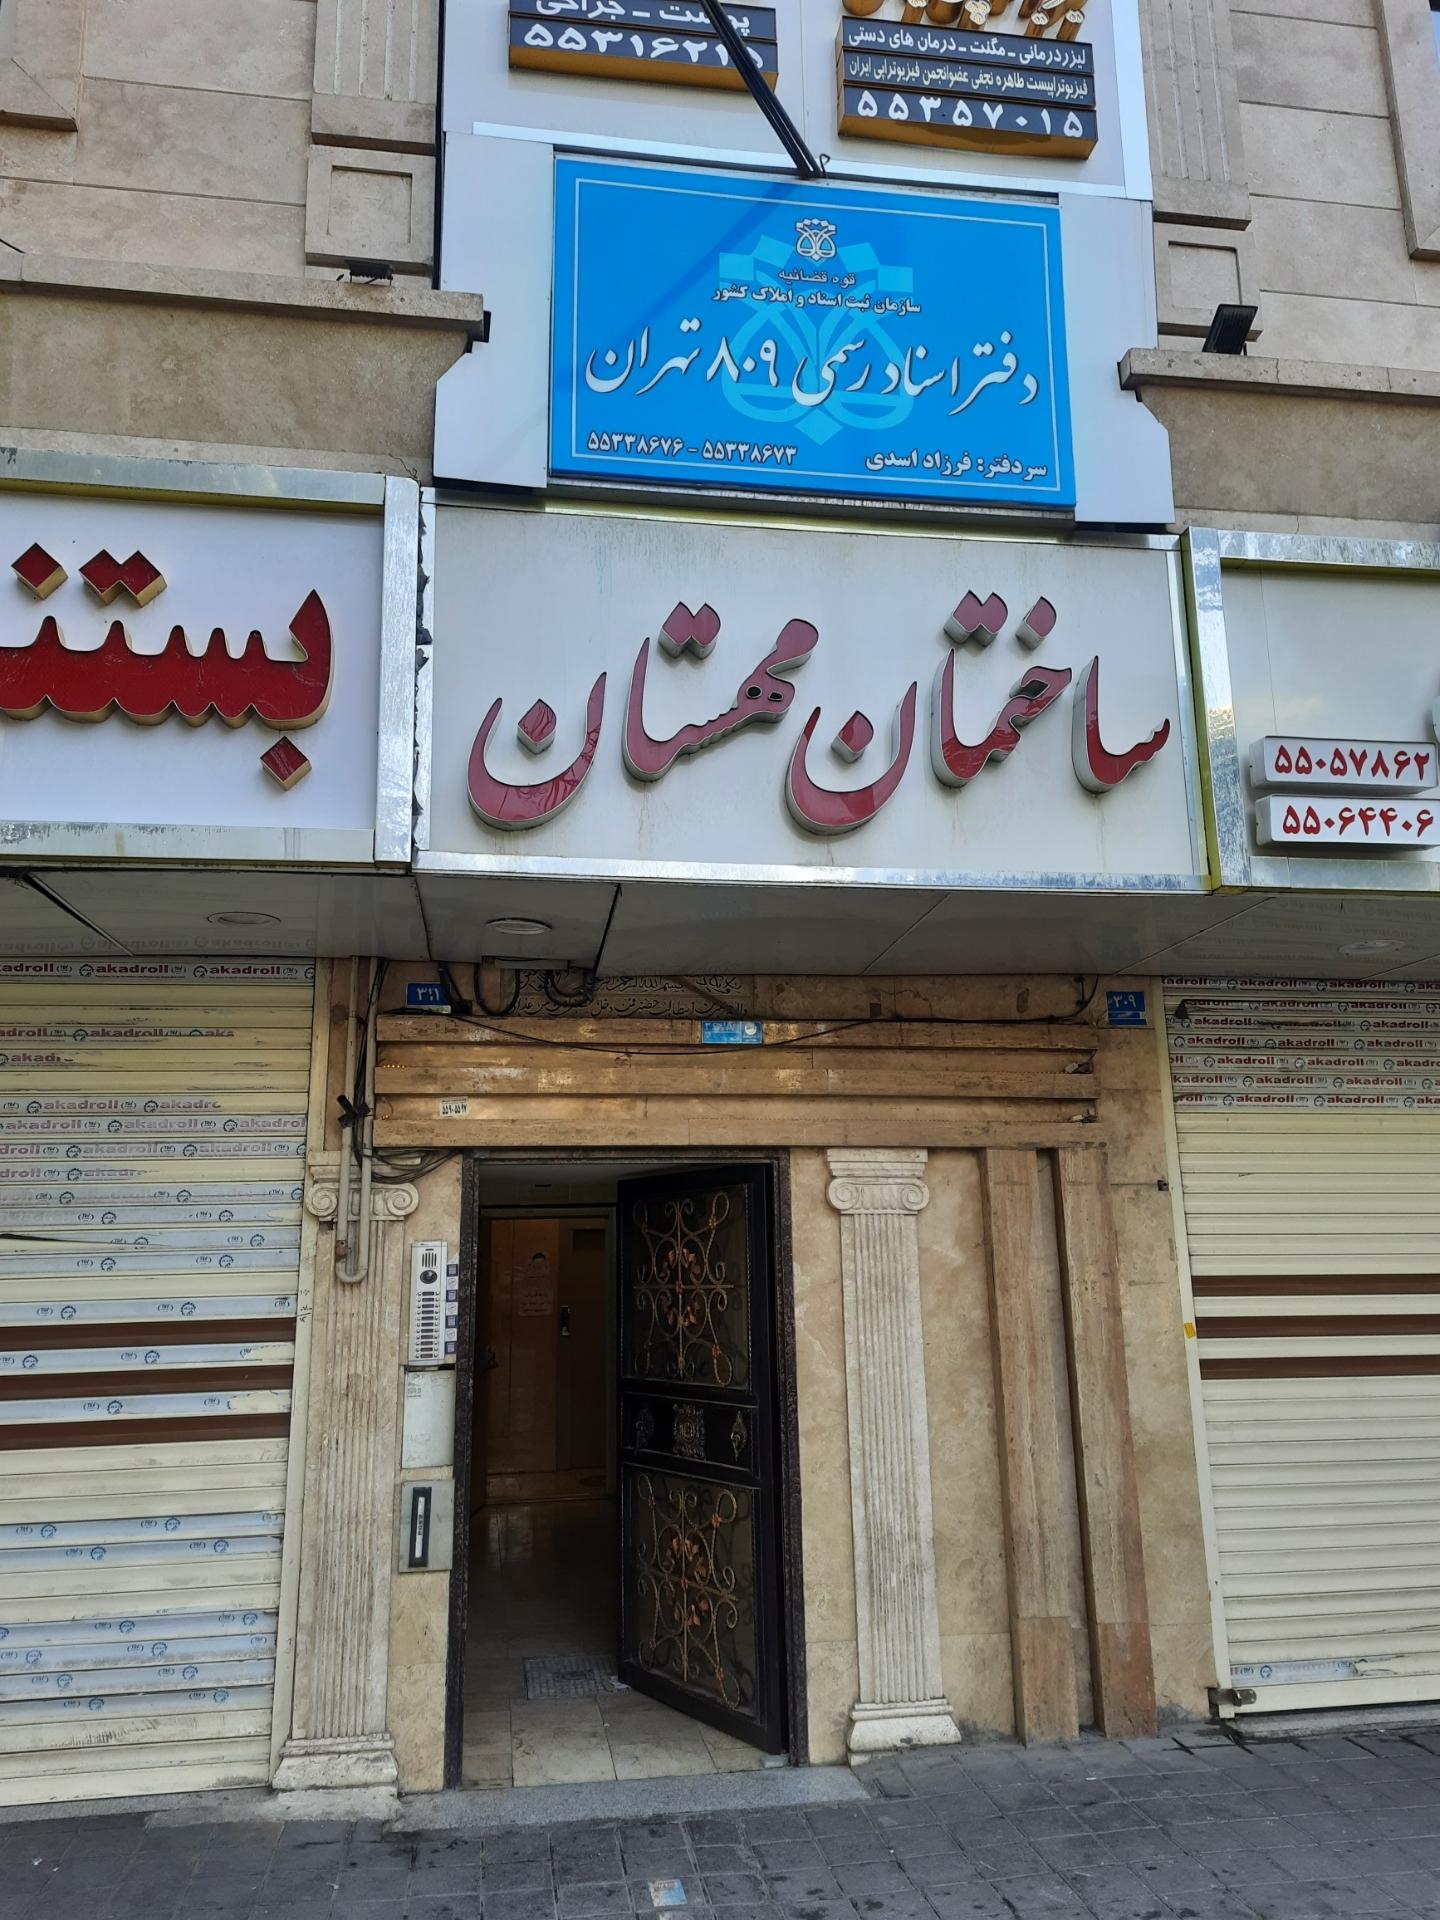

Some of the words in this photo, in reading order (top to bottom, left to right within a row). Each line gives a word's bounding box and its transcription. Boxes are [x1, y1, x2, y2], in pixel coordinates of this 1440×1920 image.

[848, 26, 886, 47] دستی
[889, 29, 915, 48] های
[917, 32, 957, 54] درمان
[970, 37, 1007, 58] مگنت
[849, 56, 872, 76] ایران
[971, 71, 994, 89] نجفی
[996, 72, 1025, 92] طاهره
[1027, 75, 1089, 100] فیزیوتراپیست
[857, 90, 1084, 138] ۵۵۳۵۷۰۱۵
[778, 268, 829, 285] قضائیه
[832, 272, 856, 290] قوه
[713, 283, 749, 300] کشور
[752, 287, 793, 303] املاک
[797, 294, 805, 308] و
[808, 291, 842, 307] اسناد
[845, 294, 870, 310] ثبت
[874, 296, 922, 317] سازمان
[584, 318, 703, 397] تهران
[706, 336, 779, 389] ۸۰۹
[791, 338, 870, 407] رسمی
[880, 344, 959, 397] اسناد
[948, 330, 1039, 416] دفتر
[866, 449, 918, 471] اسدی
[923, 451, 973, 477] فرزاد
[0, 543, 334, 791] بستن
[466, 601, 820, 831] مهستان
[785, 589, 1171, 835] ساختمان
[1275, 745, 1430, 781] ۵۵۰۵۷۸۶۲
[1282, 805, 1434, 838] ۵۵۰۶۴۴۰۶
[96, 964, 169, 974] akadroll
[210, 965, 281, 975] akadroll
[1240, 978, 1297, 988] akadroll
[1329, 980, 1386, 989] akadroll
[1373, 1020, 1429, 1029] akadroll
[1187, 1036, 1245, 1045] akadroll
[1278, 1038, 1335, 1048] akadroll
[1367, 1039, 1423, 1048] akadroll
[1217, 1056, 1275, 1065] akadroll
[1307, 1058, 1364, 1067] akadroll
[1256, 1075, 1314, 1084] akadroll
[1346, 1077, 1403, 1086] akadroll
[43, 1100, 118, 1110] akadroll
[1236, 1095, 1294, 1104] akadroll
[1327, 1096, 1384, 1104] akadroll
[6, 1120, 82, 1131] akadroll
